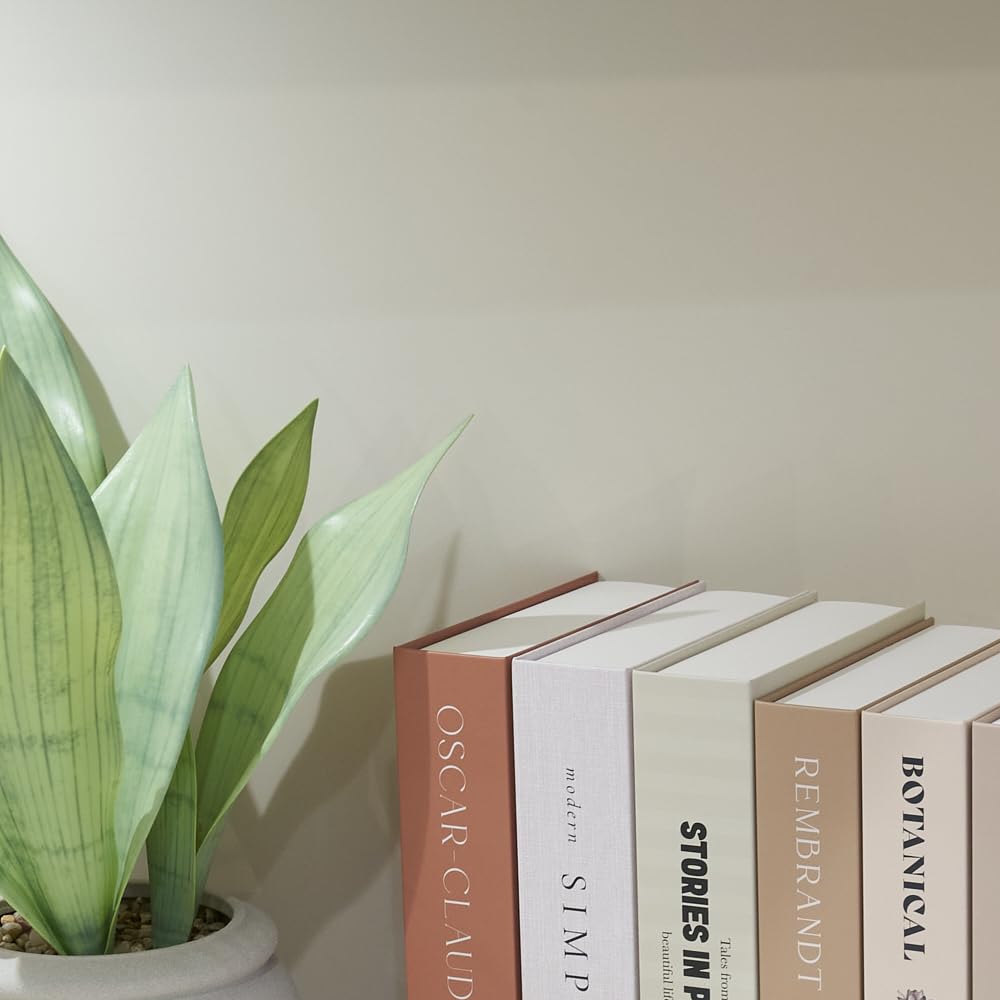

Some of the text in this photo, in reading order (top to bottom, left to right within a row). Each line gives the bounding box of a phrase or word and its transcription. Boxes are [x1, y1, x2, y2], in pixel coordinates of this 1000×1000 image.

[565, 767, 582, 843] modern
[679, 820, 710, 944] STORIES
[794, 756, 822, 991] REMBRANDT
[901, 756, 926, 961] BOTANICAL
[661, 931, 674, 984] beautiful
[682, 949, 711, 980] IN
[719, 936, 733, 970] Tales
